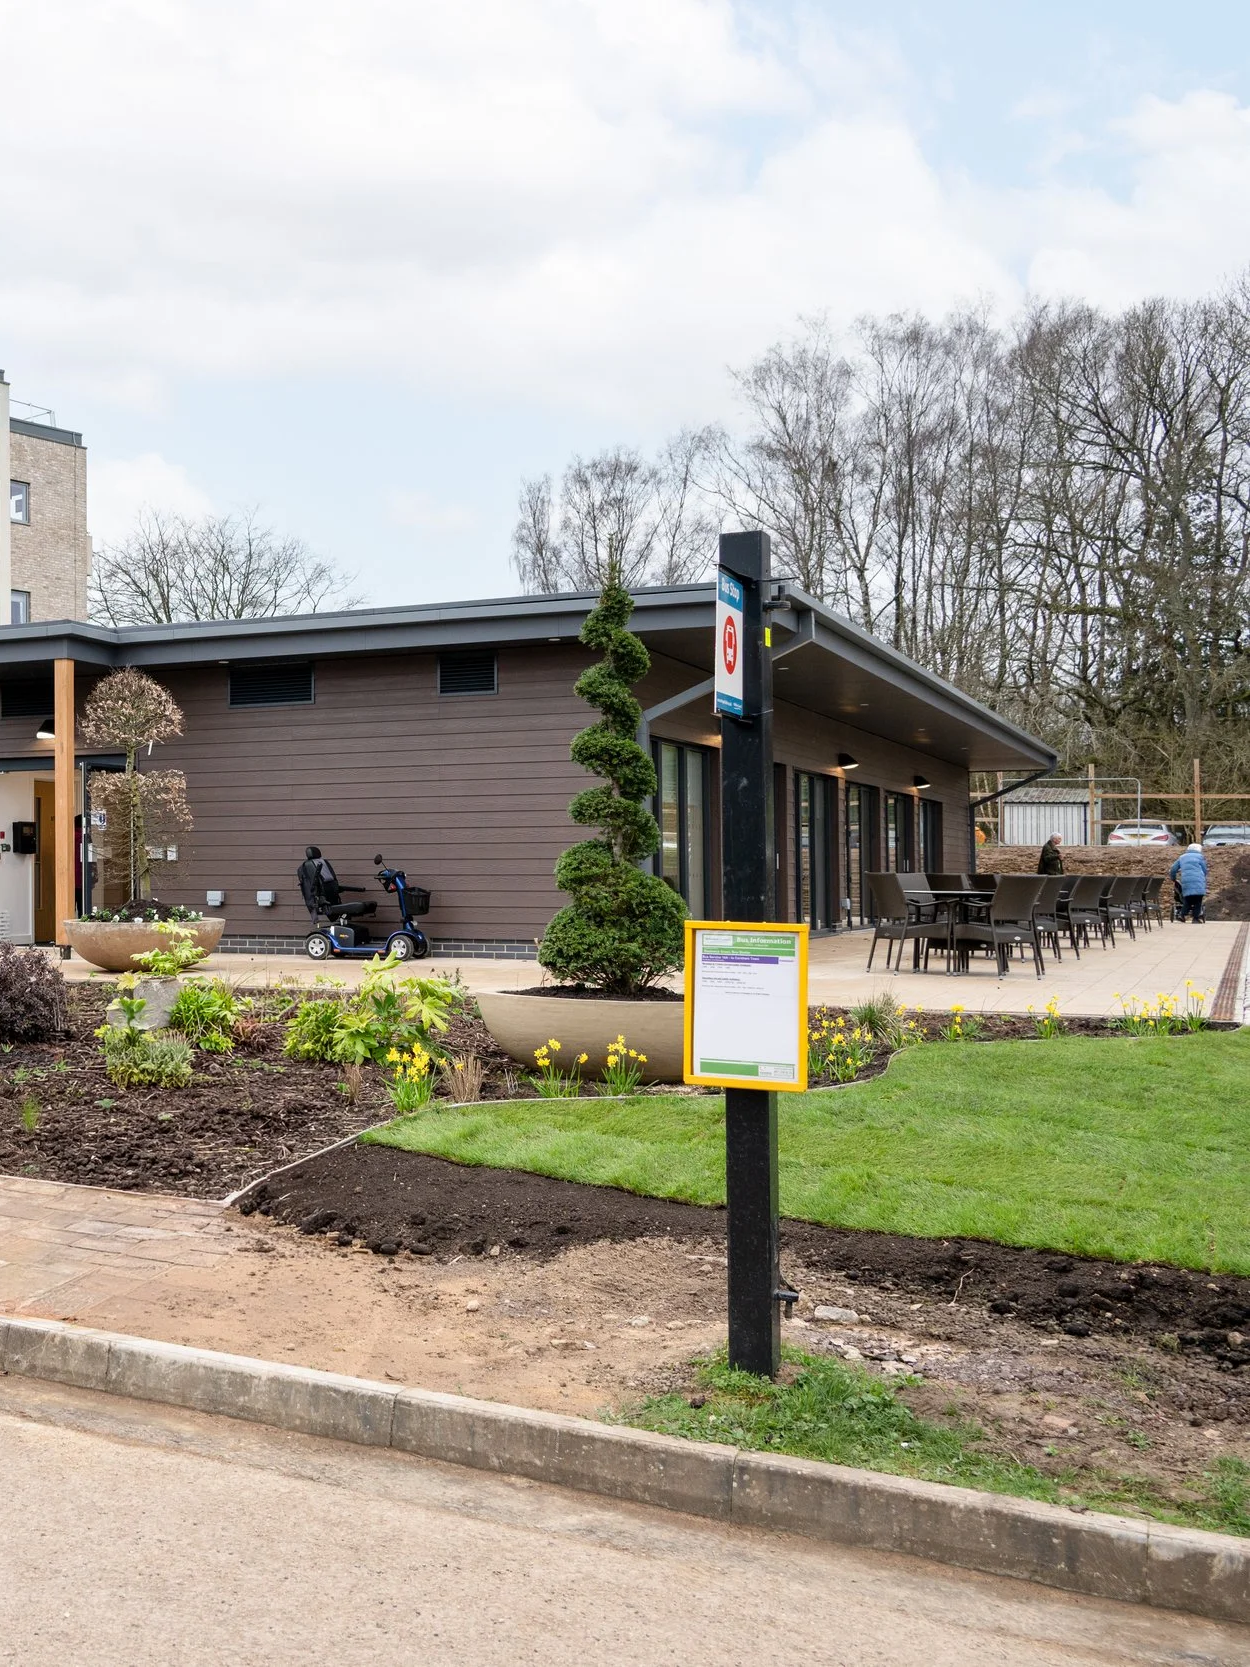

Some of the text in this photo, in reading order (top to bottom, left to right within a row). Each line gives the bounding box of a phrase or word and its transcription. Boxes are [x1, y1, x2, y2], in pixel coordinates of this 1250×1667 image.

[721, 577, 740, 603] Bus Stop
[736, 936, 748, 944] Bus
[750, 937, 792, 945] Information
